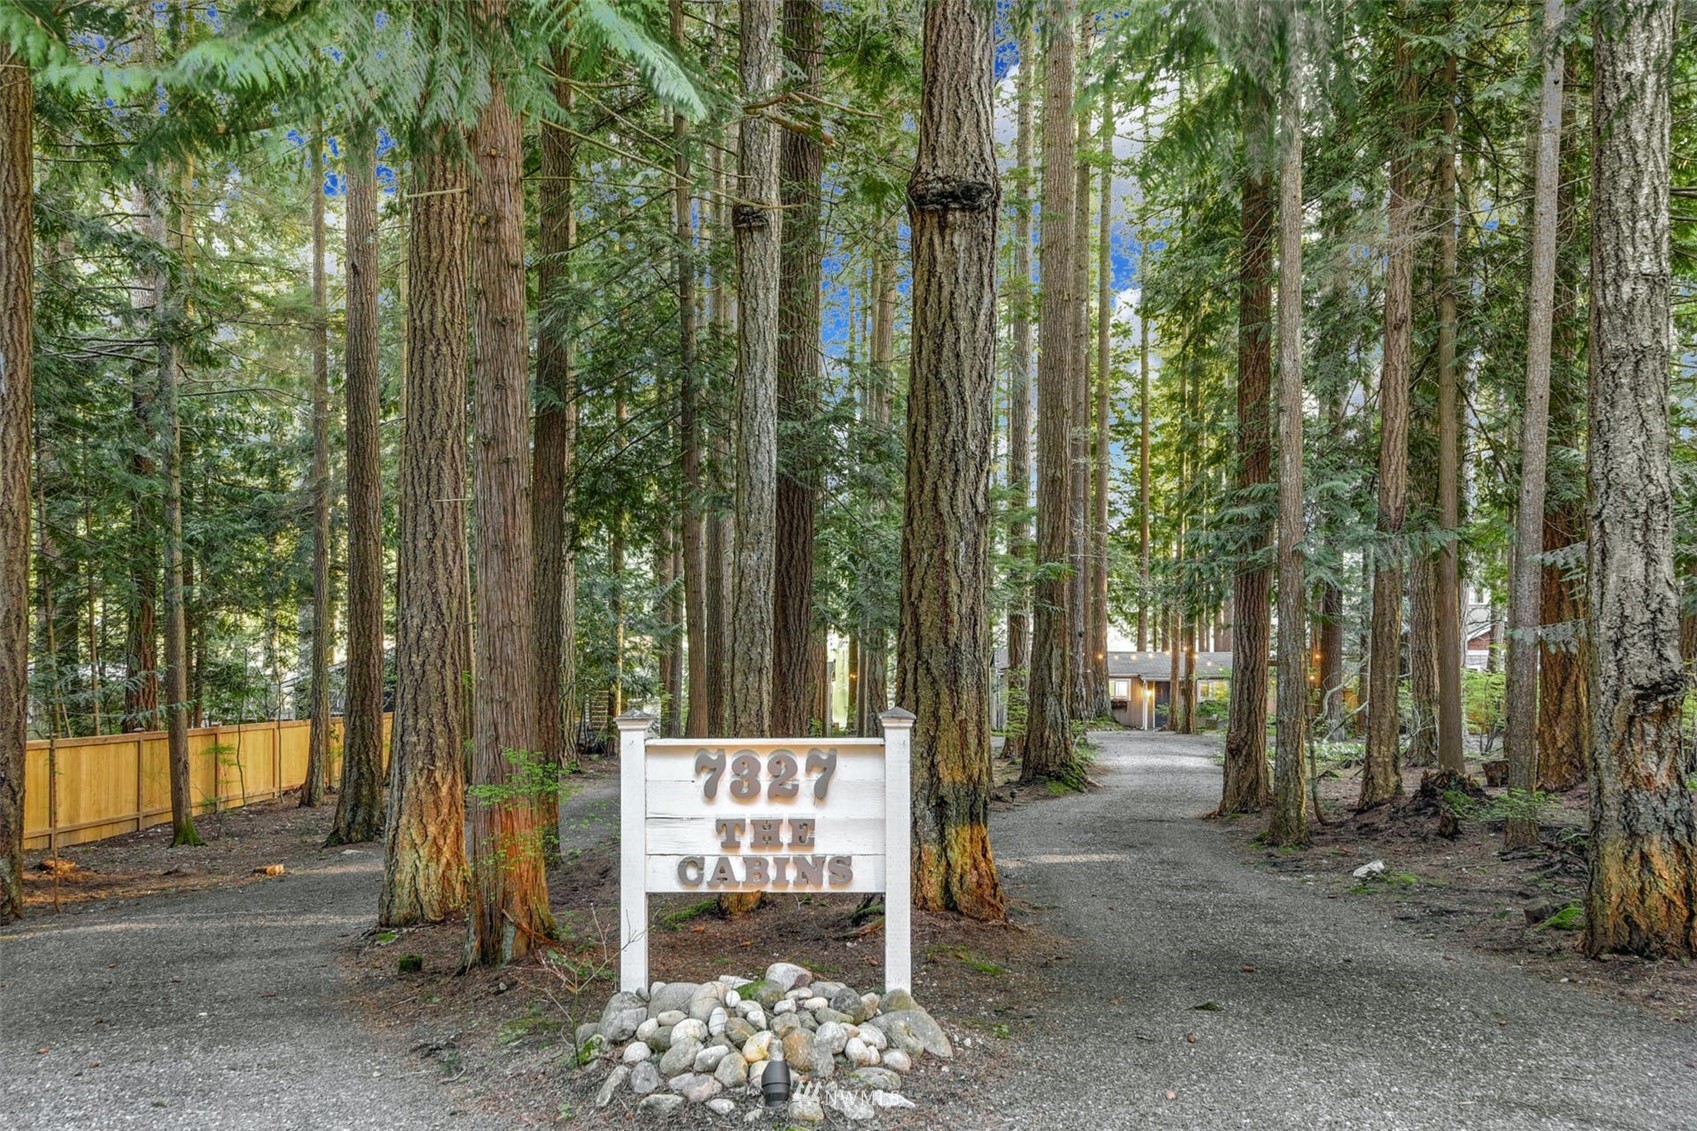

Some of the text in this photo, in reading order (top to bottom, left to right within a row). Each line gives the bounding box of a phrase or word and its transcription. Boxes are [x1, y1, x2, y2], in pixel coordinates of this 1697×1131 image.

[694, 748, 837, 800] 7327
[715, 817, 816, 849] THE
[677, 856, 854, 887] CABINS
